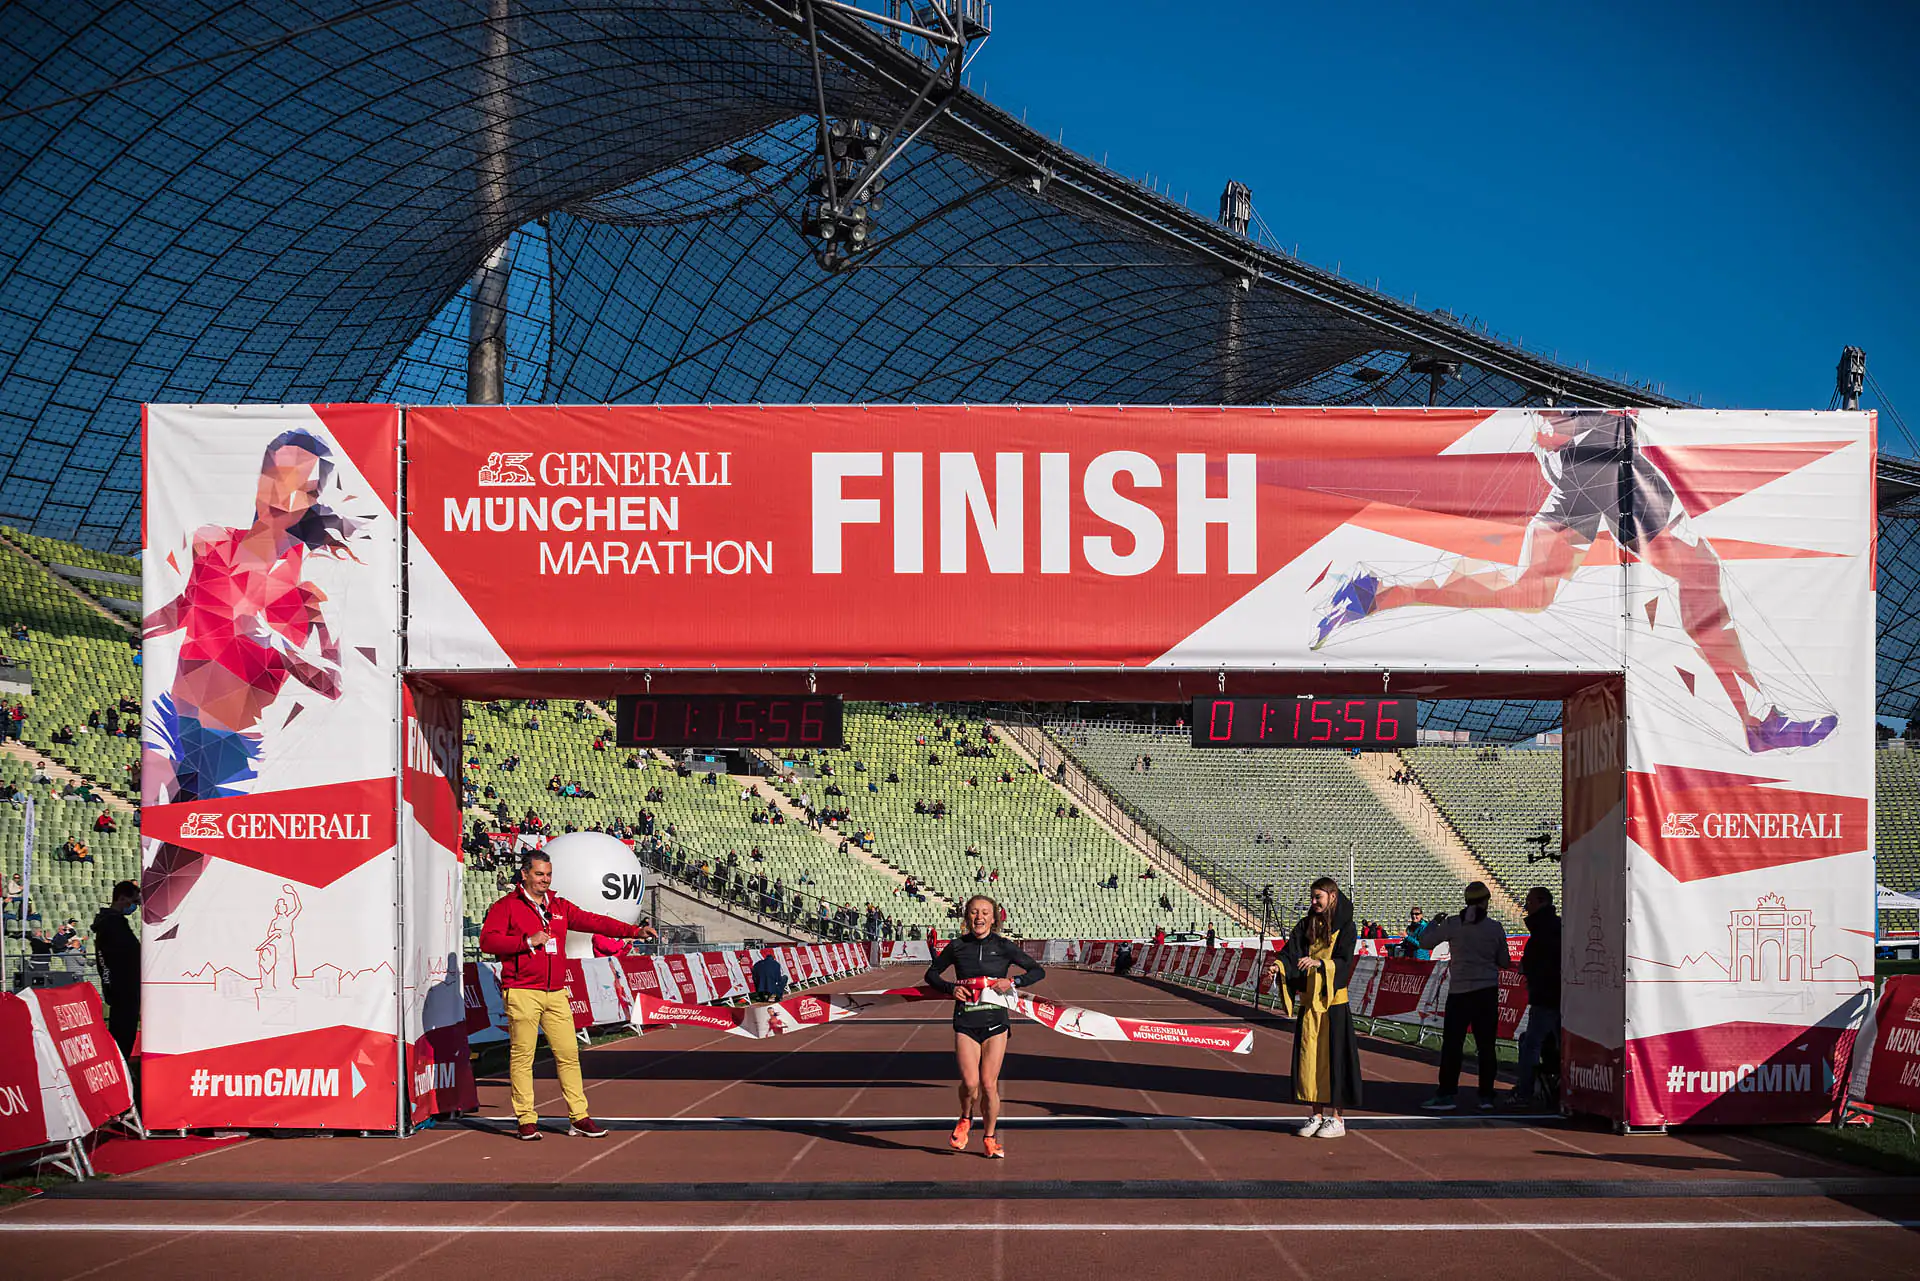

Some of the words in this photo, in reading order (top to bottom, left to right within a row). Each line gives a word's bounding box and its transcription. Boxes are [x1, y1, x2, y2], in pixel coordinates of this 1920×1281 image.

[539, 452, 732, 486] GENERALI
[444, 496, 679, 532] MÜNCHEN
[811, 450, 1258, 577] FINISH
[539, 540, 773, 575] MARATHON
[226, 813, 372, 840] GENERALI
[1703, 812, 1844, 839] GENERALI
[1133, 1031, 1180, 1042] MÜNCHEN
[1182, 1037, 1230, 1047] MARATHON
[1150, 1026, 1188, 1036] GENERALI
[189, 1067, 339, 1098] #runGMM
[1666, 1063, 1812, 1093] #runGMM
